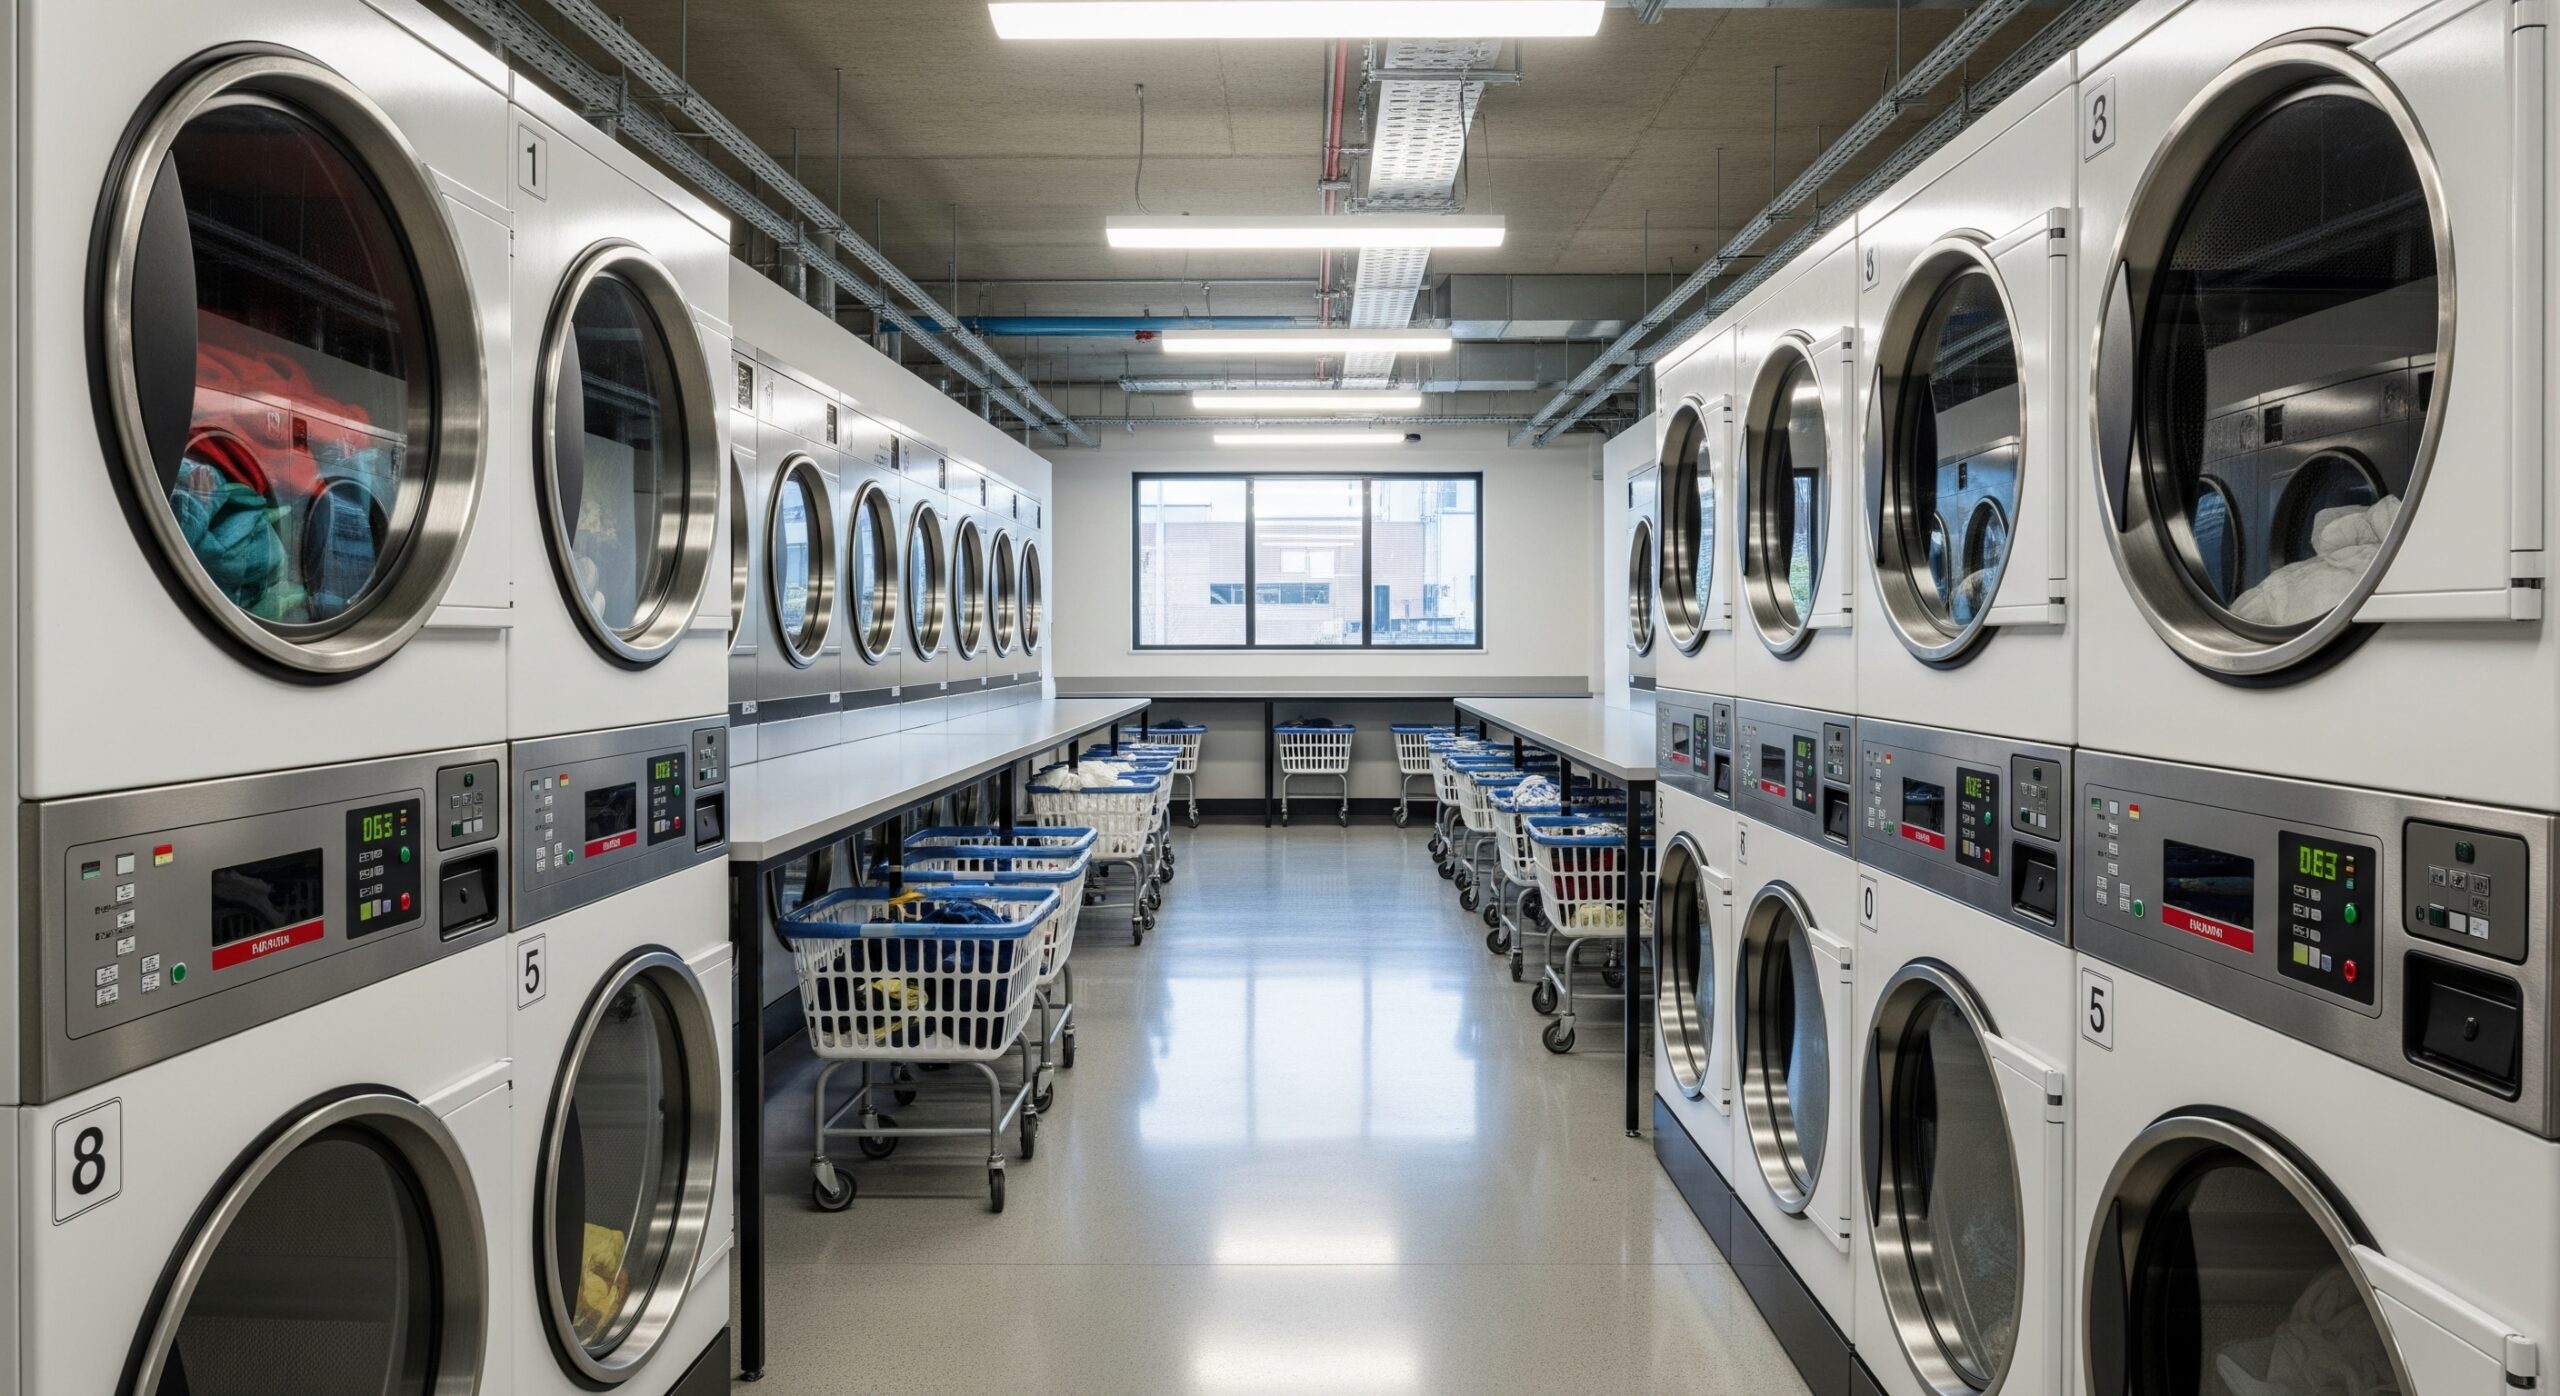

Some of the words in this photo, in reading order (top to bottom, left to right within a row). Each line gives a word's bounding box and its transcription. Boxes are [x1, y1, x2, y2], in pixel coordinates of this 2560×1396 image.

[526, 142, 536, 187] 1
[525, 948, 540, 994] 5
[2090, 986, 2105, 1033] 5
[72, 1126, 106, 1195] 8
